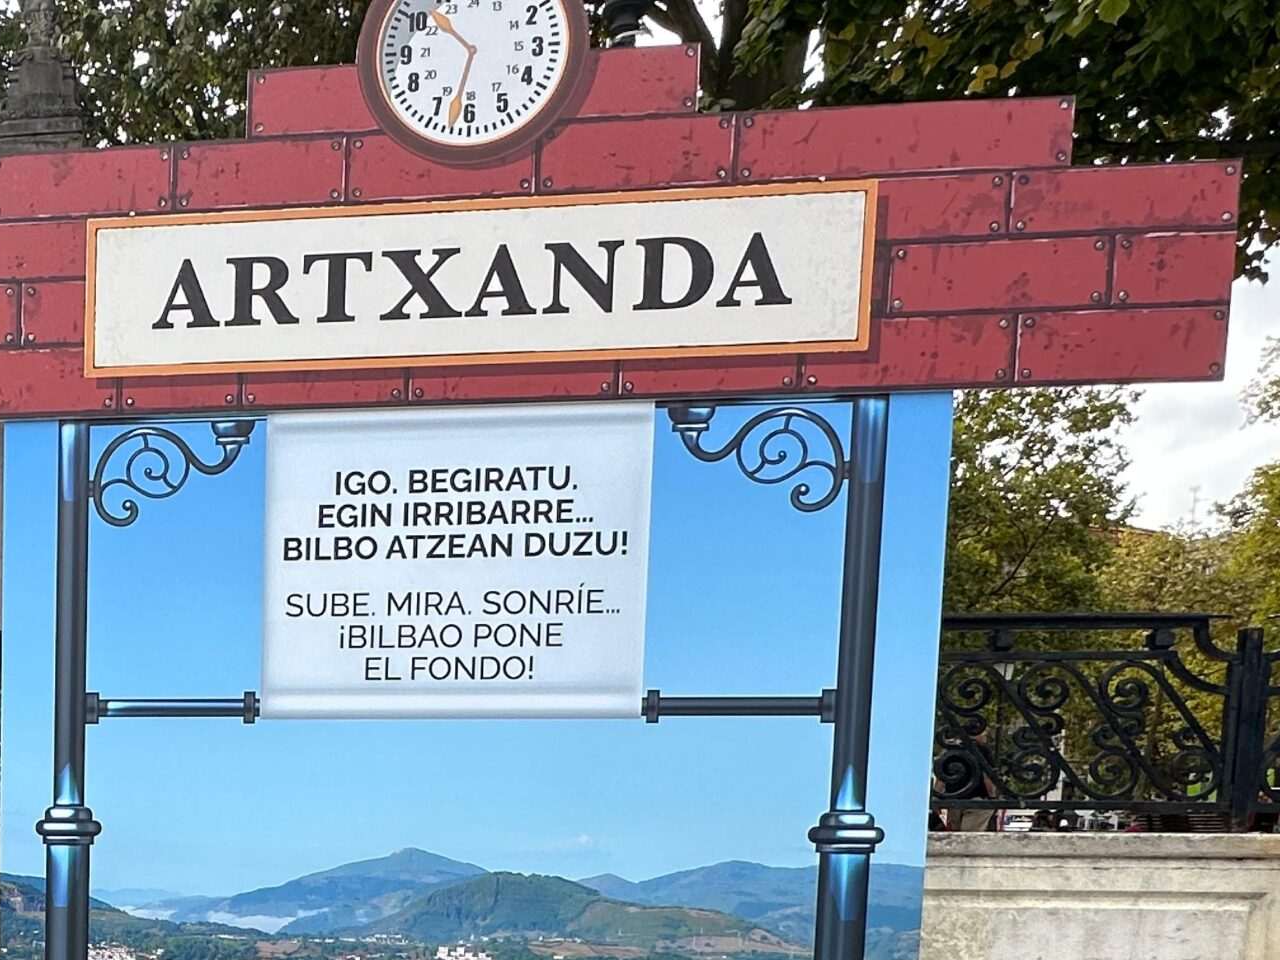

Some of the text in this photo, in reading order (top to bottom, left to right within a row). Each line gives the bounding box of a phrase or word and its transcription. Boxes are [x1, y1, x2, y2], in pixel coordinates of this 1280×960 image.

[445, 4, 458, 14] 23
[492, 1, 502, 11] 13
[525, 5, 538, 25] 2
[408, 11, 428, 32] 10
[425, 26, 438, 36] 22
[509, 20, 519, 30] 14
[400, 45, 413, 65] 9
[420, 48, 431, 57] 21
[514, 41, 524, 51] 15
[531, 36, 544, 57] 3
[424, 70, 437, 80] 20
[506, 64, 519, 74] 16
[520, 65, 533, 86] 4
[407, 72, 420, 92] 8
[442, 86, 453, 96] 19
[491, 82, 502, 92] 17
[466, 91, 476, 100] 18
[496, 92, 509, 113] 5
[432, 96, 442, 116] 7
[463, 103, 476, 124] 6
[151, 232, 793, 330] ARTXANDA
[335, 465, 578, 496] IGO. BEGIRATU.
[318, 498, 594, 529] EGIN IRRIBARRE...
[283, 530, 628, 561] BILBO ATZEAN DUZU!
[285, 582, 621, 618] SUBE. MIRA. SONRÍE...
[339, 622, 564, 649] ¡BILBAO PONE
[364, 655, 534, 681] EL FONDO!
